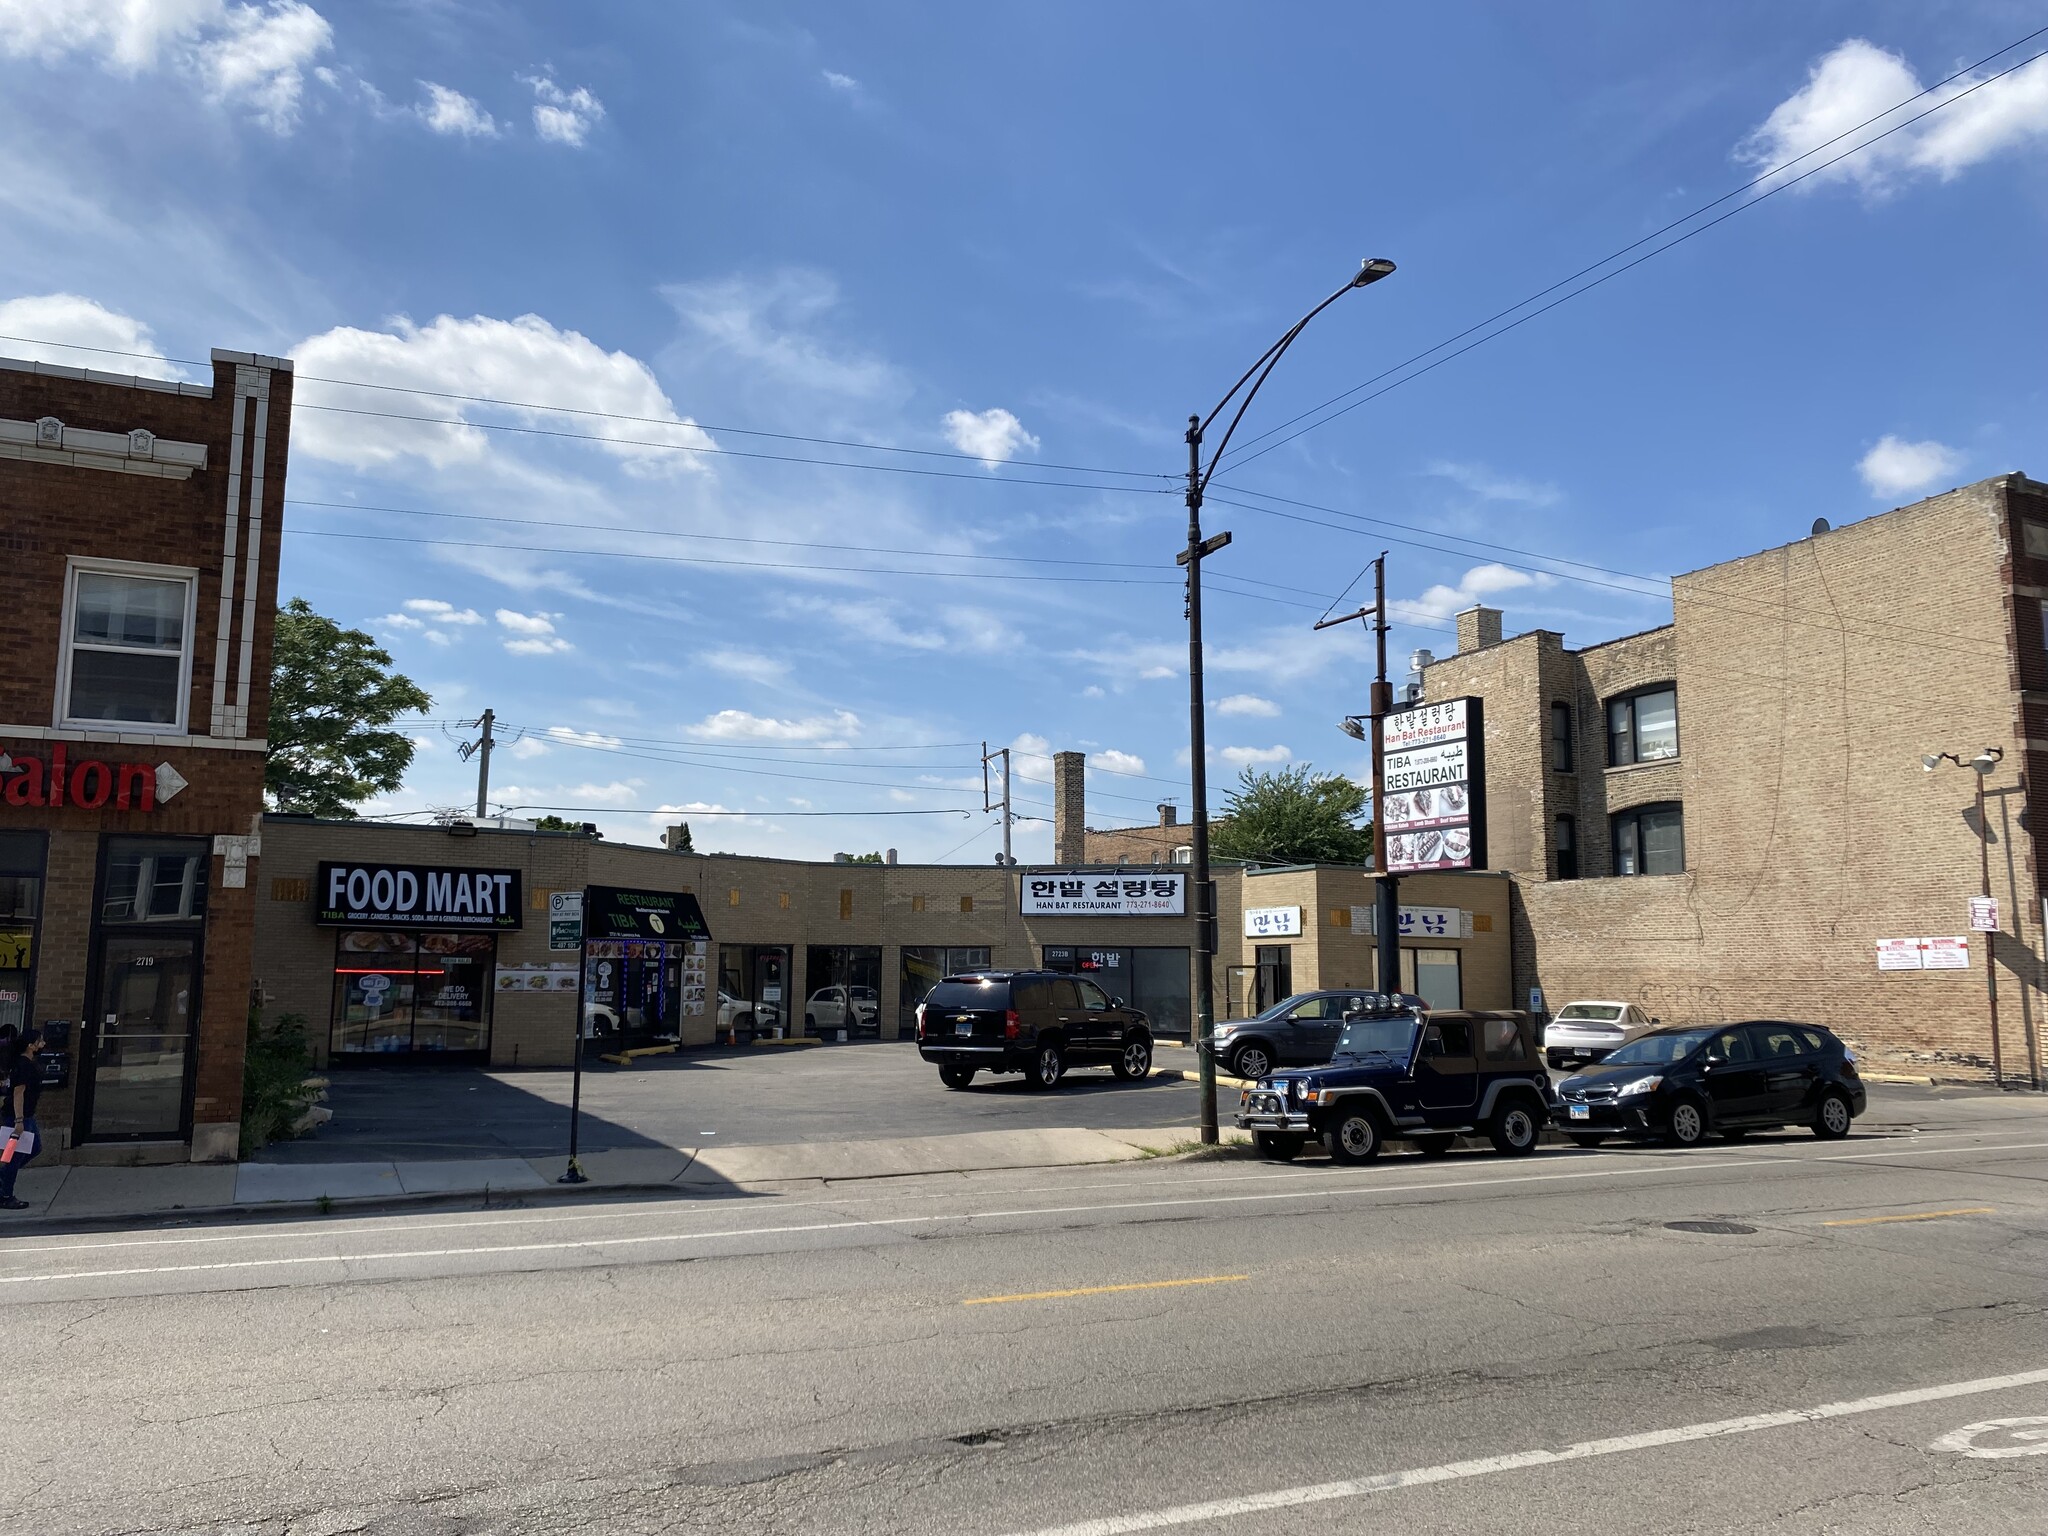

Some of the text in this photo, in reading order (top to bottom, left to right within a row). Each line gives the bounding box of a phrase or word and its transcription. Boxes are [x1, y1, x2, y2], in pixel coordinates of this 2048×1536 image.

[1385, 721, 1465, 744] Han Bat Restaurant
[1387, 755, 1412, 770] TIBA
[0, 743, 157, 812] alon
[1387, 763, 1464, 789] RESTAURANT
[329, 868, 512, 914] FOOD MART
[1030, 880, 1178, 898] 한밭 설렁탕
[616, 893, 675, 908] RESTAURANT
[1036, 901, 1054, 909] HAN
[1126, 900, 1170, 909] 773-271-8640
[322, 911, 346, 919] TIBA
[607, 913, 639, 928] TIBA
[652, 919, 661, 931] T
[136, 956, 153, 967] 2719
[438, 992, 469, 1000] DELIVERY
[444, 985, 465, 993] WE DO
